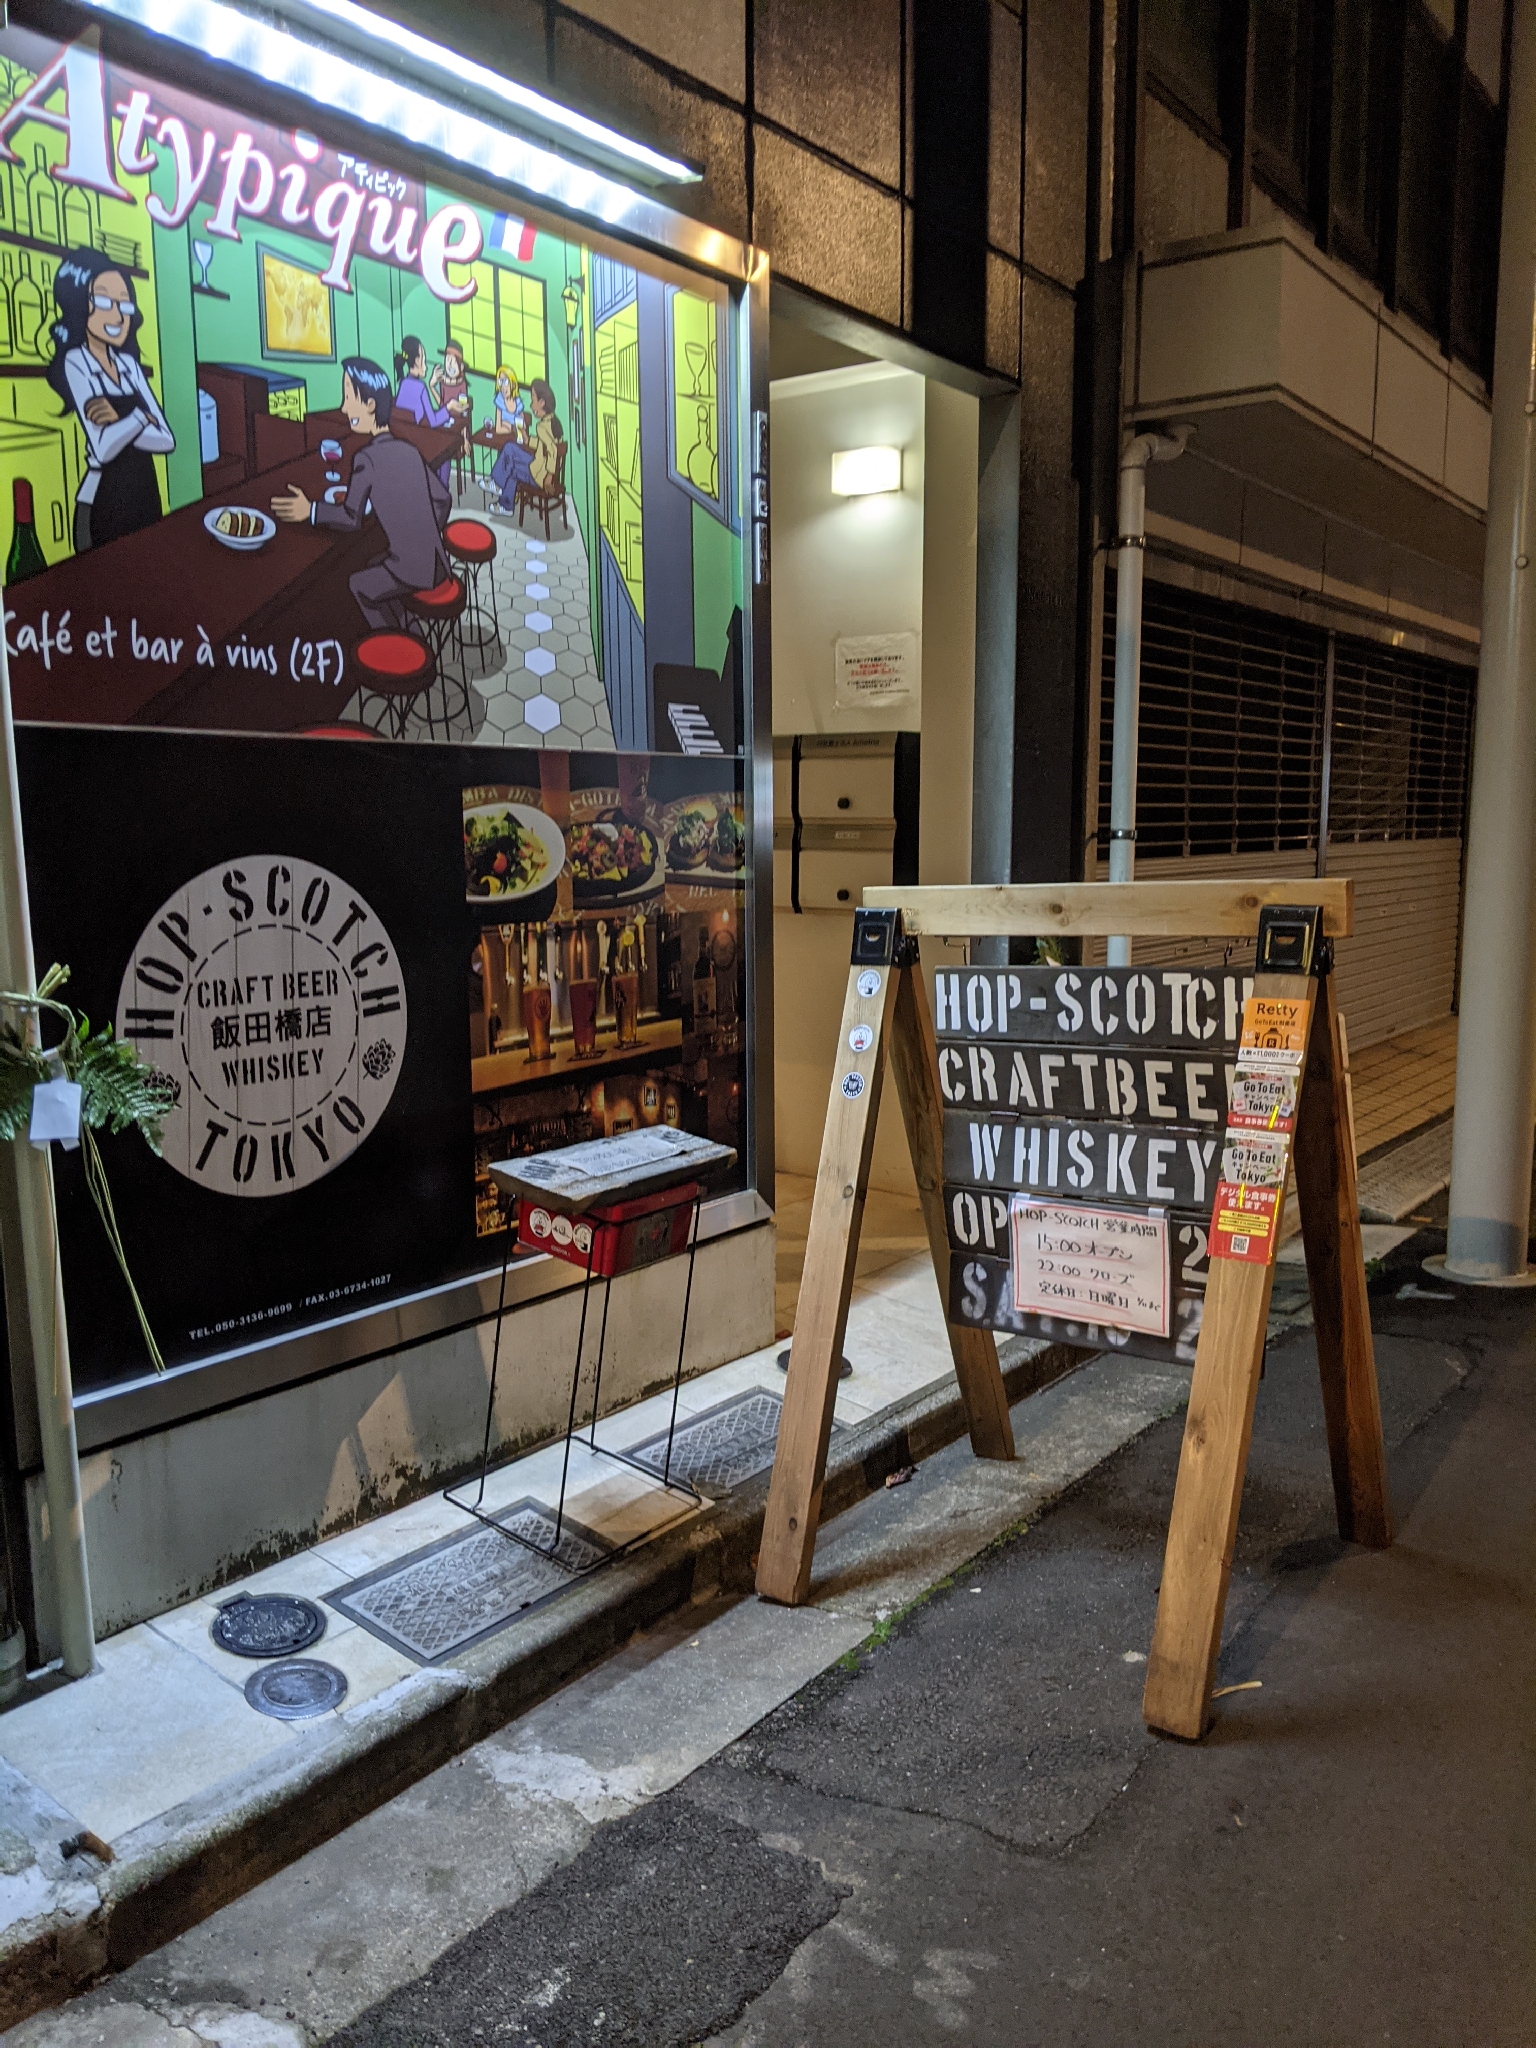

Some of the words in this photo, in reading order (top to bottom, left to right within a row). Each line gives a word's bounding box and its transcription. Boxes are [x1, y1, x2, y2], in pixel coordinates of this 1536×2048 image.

[0, 22, 484, 303] Atypique
[337, 152, 407, 202] アティピック
[85, 615, 118, 659] et
[131, 618, 184, 665] bar
[195, 624, 216, 668] à
[226, 644, 279, 676] vins
[289, 636, 345, 686] (2F)
[197, 975, 274, 1009] CRAFT
[282, 969, 339, 1001] BEER
[935, 972, 1254, 1042] HOP-SCOTCH
[209, 1004, 333, 1051] 飯田橋店
[1256, 1002, 1299, 1020] Retty
[220, 1047, 325, 1089] WHISKEY
[1243, 1081, 1256, 1093] Go
[1257, 1082, 1268, 1094] To
[1269, 1083, 1285, 1096] Eat
[194, 1095, 367, 1184] TOKYO
[1231, 1147, 1244, 1160] Go
[1246, 1148, 1258, 1162] To
[1258, 1150, 1277, 1165] Eat
[969, 1122, 1217, 1203] WHISKEY
[1236, 1168, 1266, 1184] Tokyo
[1227, 1197, 1265, 1212] 使ます。
[1037, 1232, 1082, 1254] 15:00
[1085, 1240, 1133, 1261] オープン
[1037, 1258, 1082, 1277] 22:00
